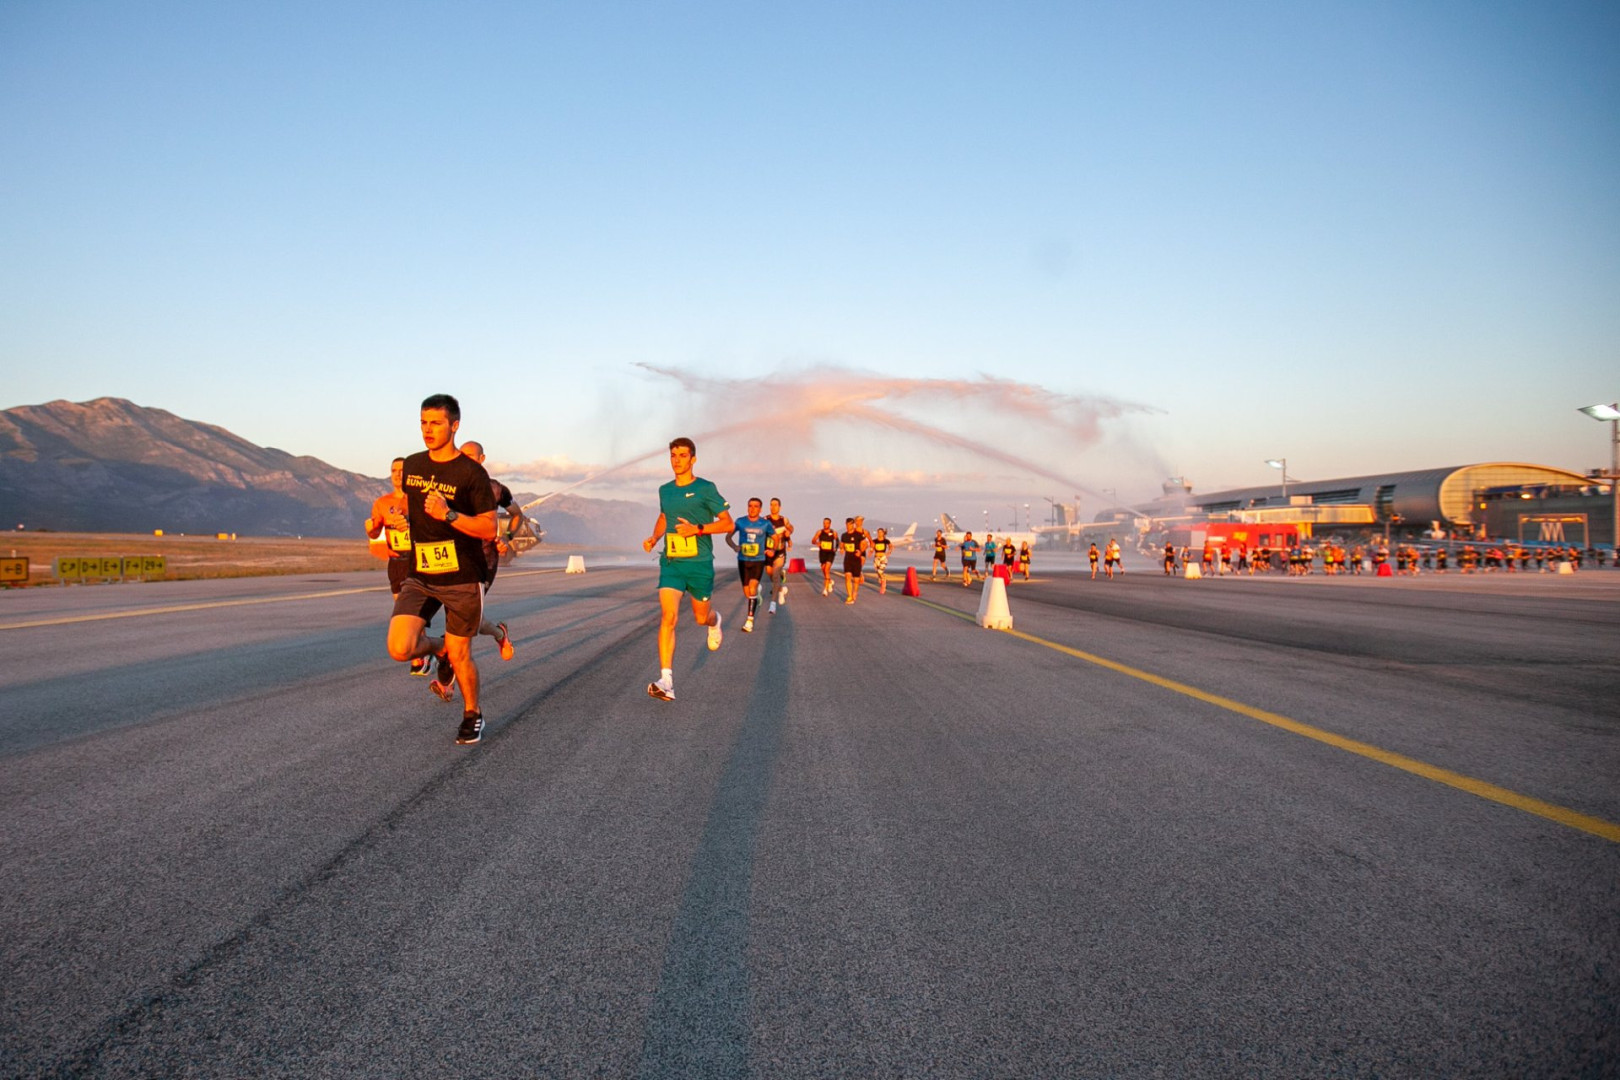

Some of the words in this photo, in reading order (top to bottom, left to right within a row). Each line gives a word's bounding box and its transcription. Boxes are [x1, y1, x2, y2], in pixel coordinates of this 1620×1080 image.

[406, 477, 438, 490] RUNWAY
[438, 482, 457, 494] RUN
[434, 546, 449, 560] 54
[15, 563, 22, 575] B
